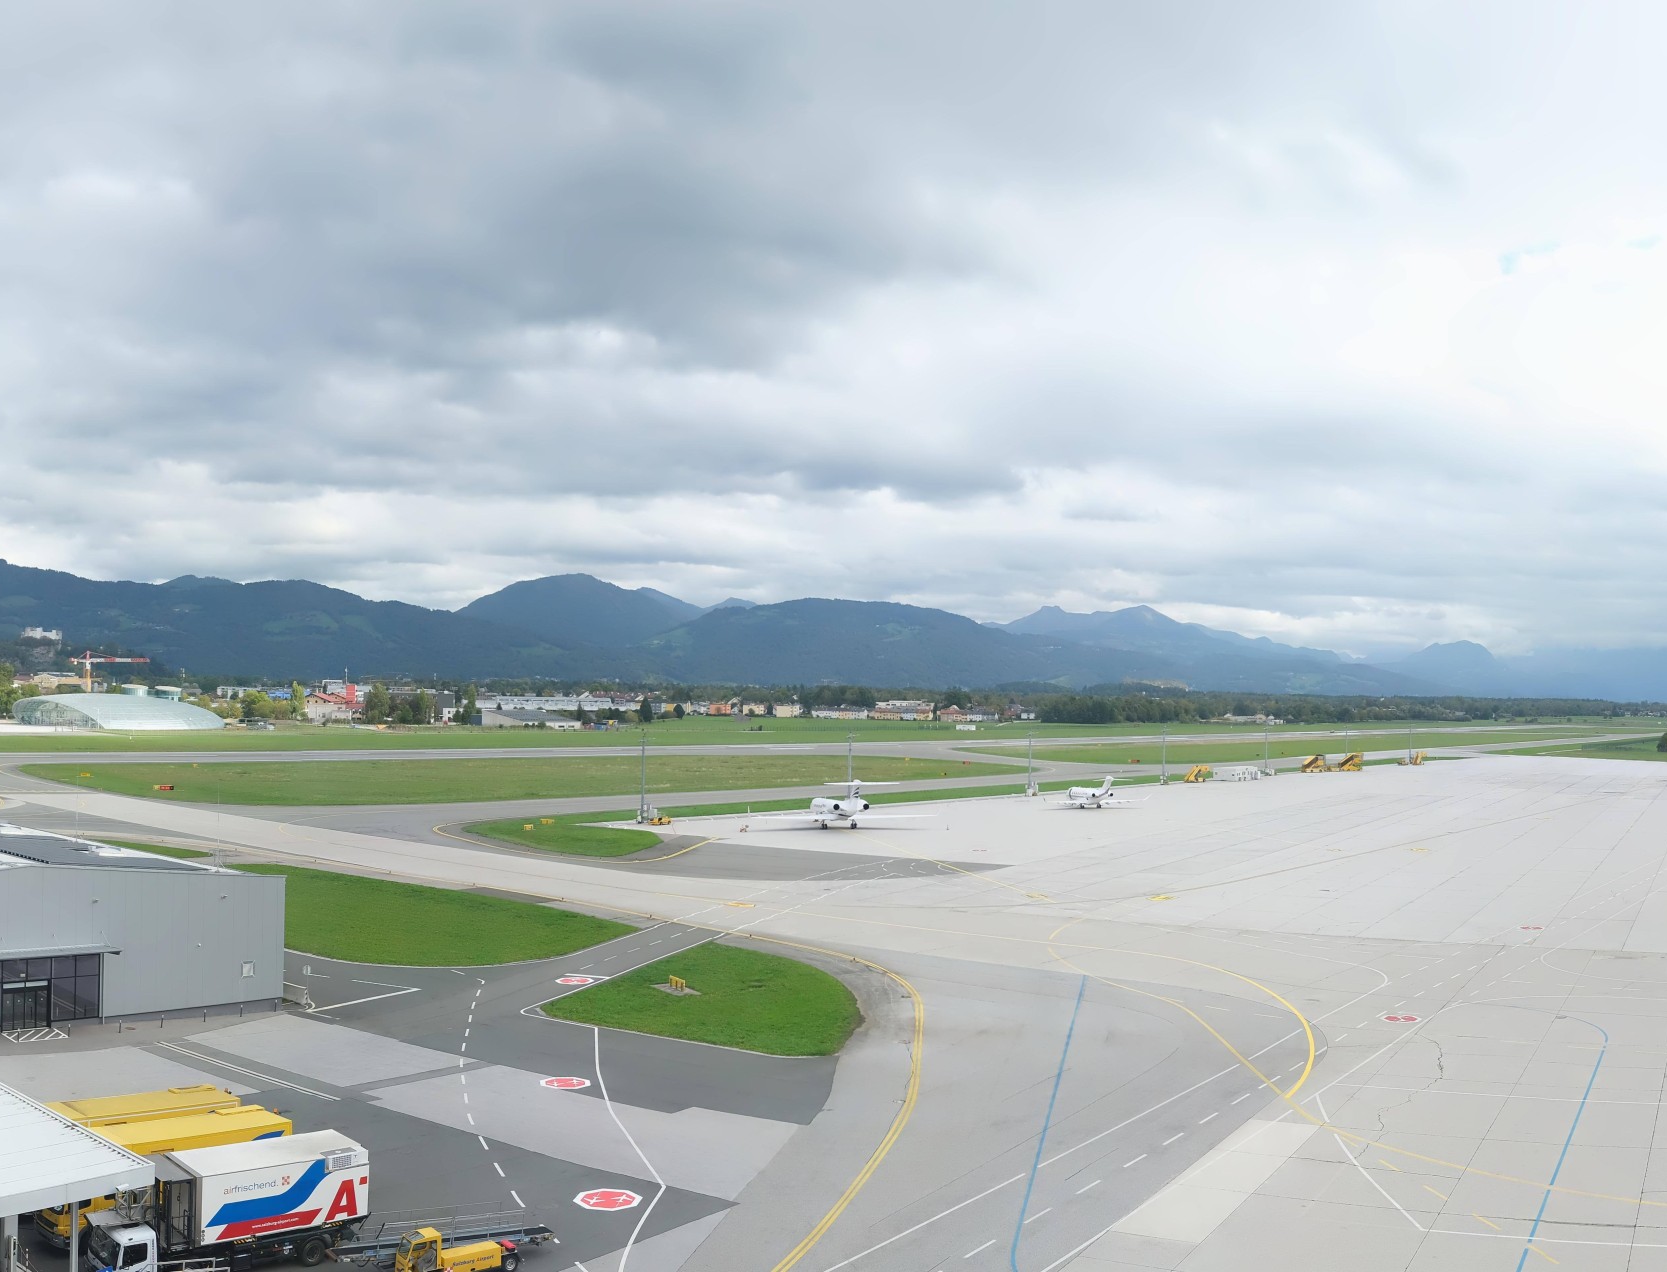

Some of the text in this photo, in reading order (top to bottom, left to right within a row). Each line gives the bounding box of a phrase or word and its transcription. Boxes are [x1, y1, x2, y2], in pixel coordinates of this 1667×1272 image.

[223, 1179, 279, 1195] airfrischend.
[452, 1254, 495, 1267] Salzburg Airport
